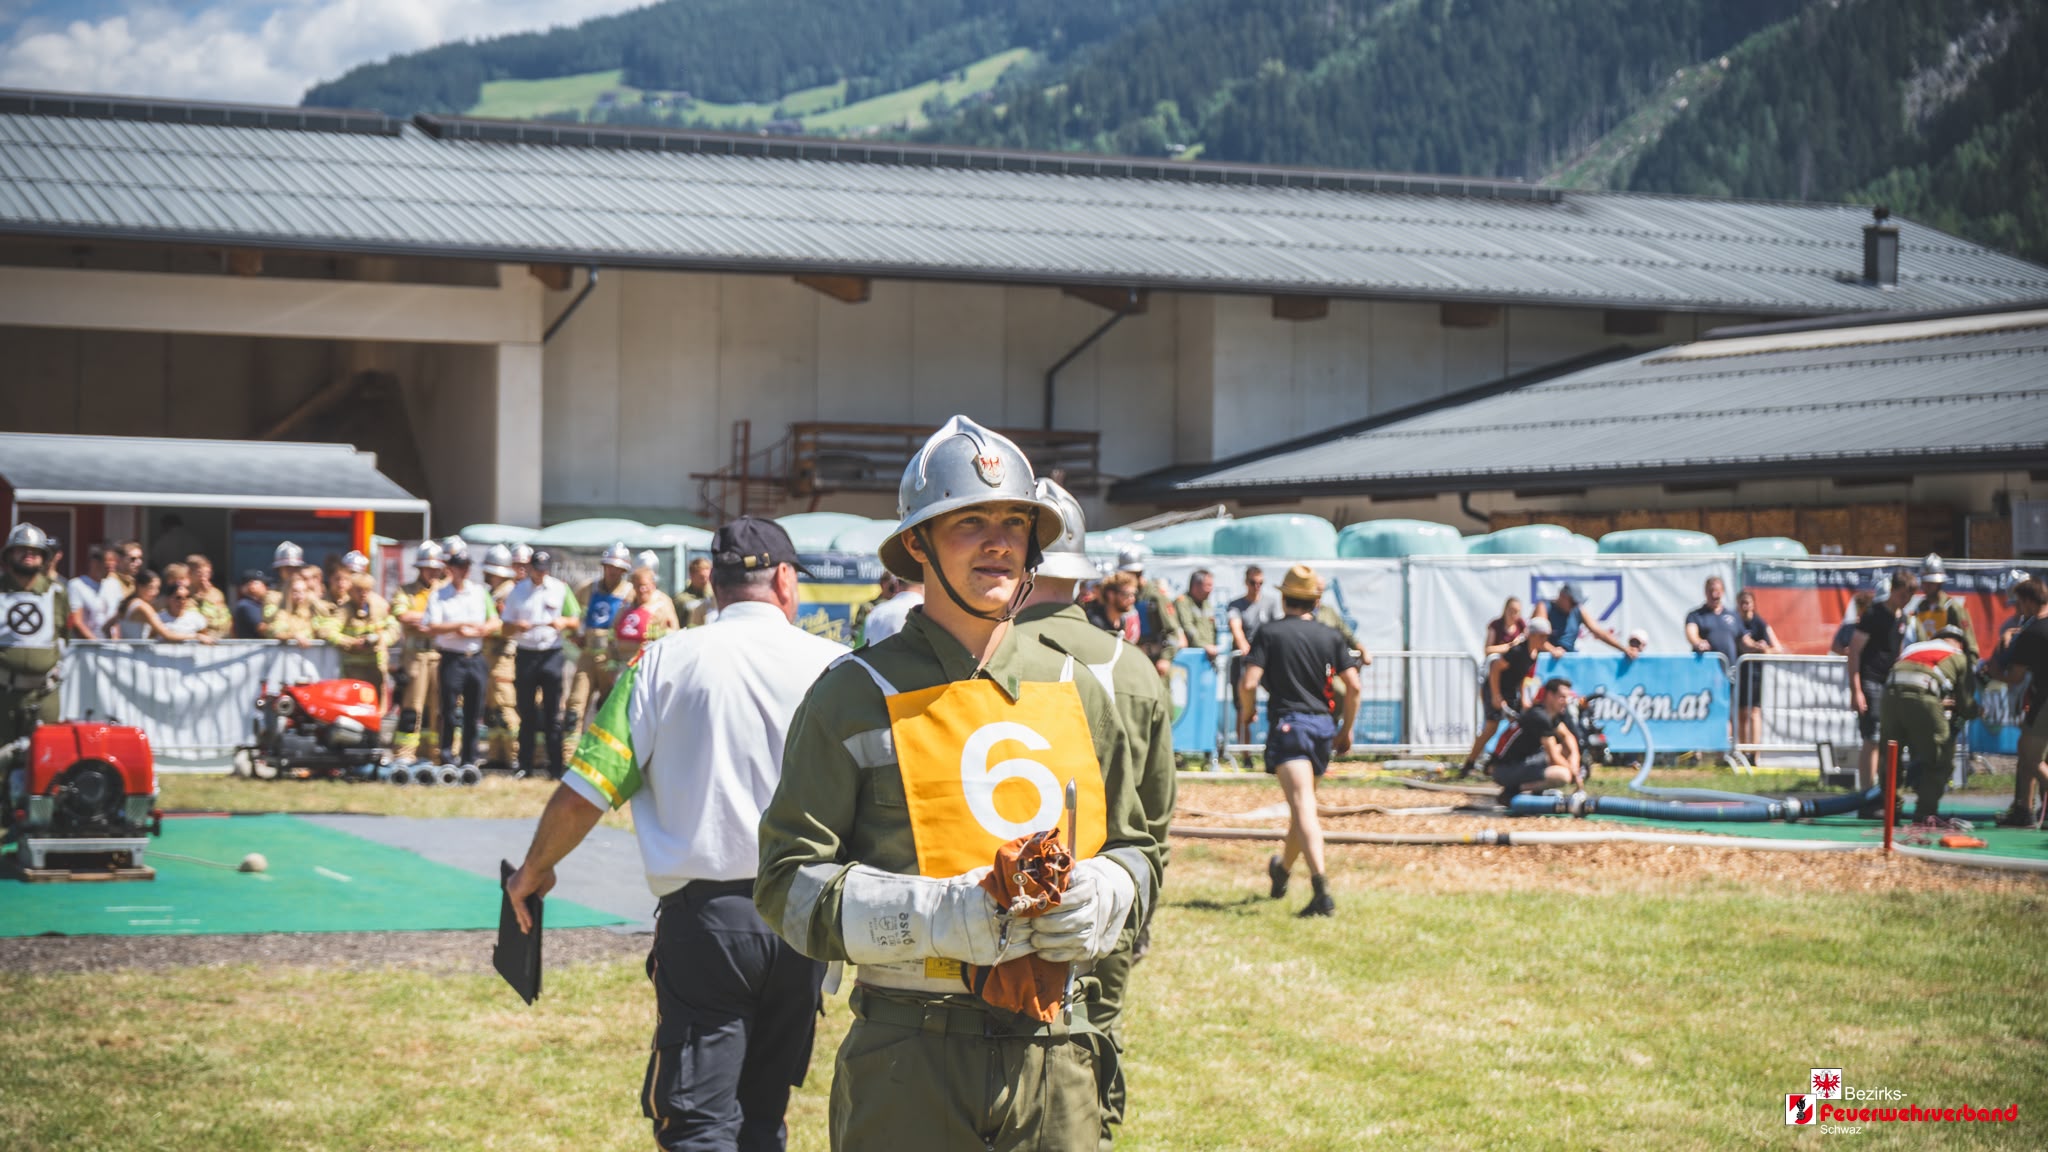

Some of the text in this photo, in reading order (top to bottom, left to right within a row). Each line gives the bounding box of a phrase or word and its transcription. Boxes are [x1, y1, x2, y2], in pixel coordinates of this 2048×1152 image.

[593, 601, 611, 624] 3
[621, 613, 640, 635] 2
[961, 721, 1063, 840] 6
